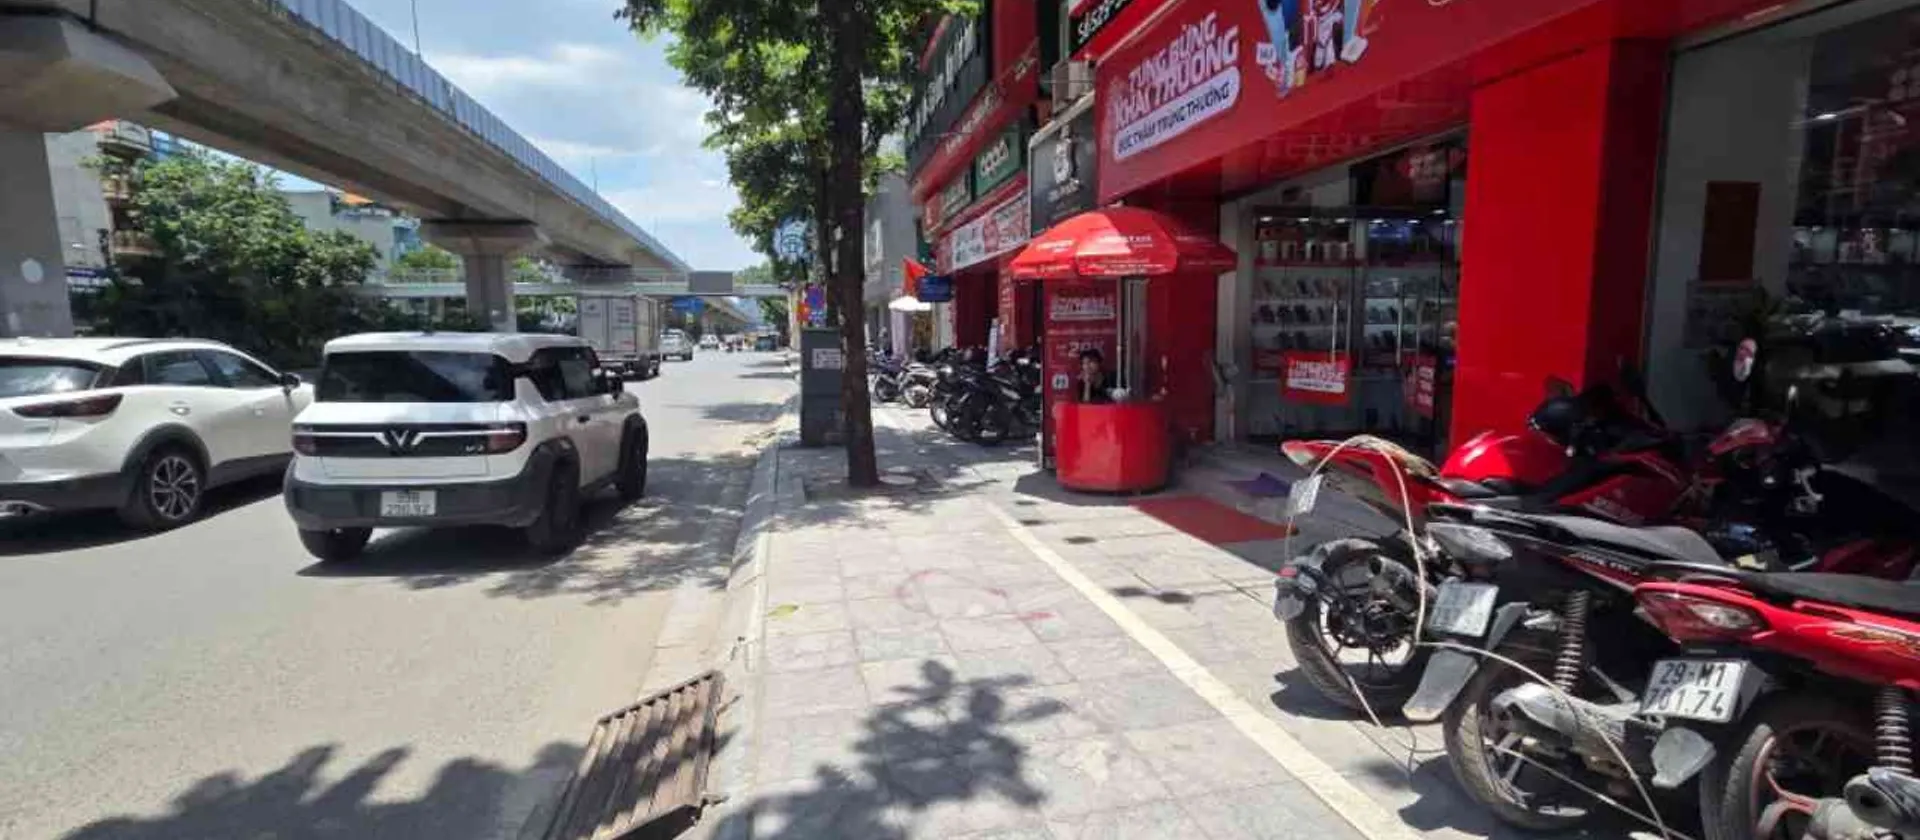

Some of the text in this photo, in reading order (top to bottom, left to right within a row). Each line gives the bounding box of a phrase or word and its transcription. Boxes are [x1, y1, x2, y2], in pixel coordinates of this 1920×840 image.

[1114, 83, 1151, 130] KHAI
[1150, 24, 1240, 107] TRƯƠNG
[1659, 662, 1726, 687] 29-M1
[1644, 687, 1725, 717] 701.74
